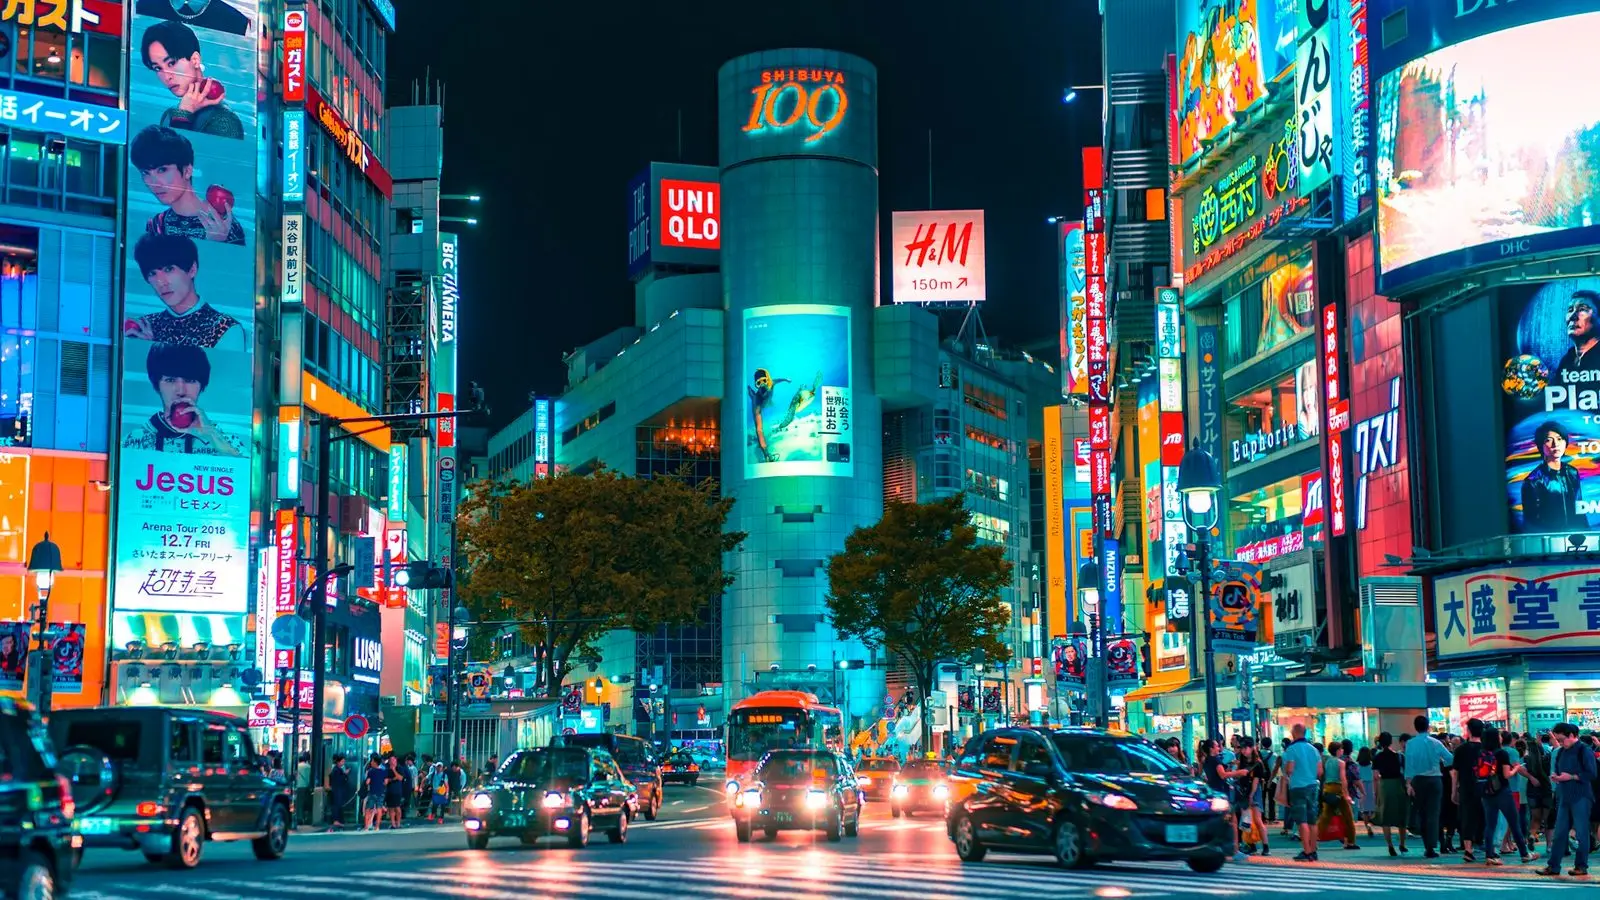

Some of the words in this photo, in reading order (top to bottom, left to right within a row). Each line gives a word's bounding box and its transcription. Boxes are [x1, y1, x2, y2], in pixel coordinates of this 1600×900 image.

[288, 49, 302, 92] ガスト
[762, 70, 845, 83] SHIBUYA
[742, 82, 848, 142] 109
[668, 188, 714, 214] UNI
[1220, 173, 1256, 234] 西村
[668, 215, 719, 242] QLO
[286, 219, 298, 295] 渋谷駅前ビル
[442, 242, 454, 270] BIC
[905, 222, 973, 267] H&M
[1500, 239, 1530, 256] DHC
[912, 278, 952, 291] 150m
[826, 396, 848, 406] 世界に
[1545, 384, 1600, 412] Pla
[826, 406, 848, 419] 出会
[826, 419, 849, 431] おう
[1201, 366, 1219, 470] サマーフルー
[1163, 433, 1181, 445] JTB
[1232, 420, 1294, 463] Euphoria
[1355, 376, 1400, 530] クスリ
[136, 463, 234, 496] Jesus
[193, 465, 209, 473] NEW
[440, 457, 454, 482] OS
[142, 522, 172, 532] Arena
[176, 524, 198, 533] Tour
[201, 525, 226, 535] 2018
[160, 534, 192, 547] 12.7
[195, 540, 211, 549] FRI
[132, 550, 232, 562] さいたまスーパーアリーナ
[138, 568, 223, 597] 超特急
[1107, 550, 1115, 592] MIZUHO
[355, 637, 382, 671] LUSH
